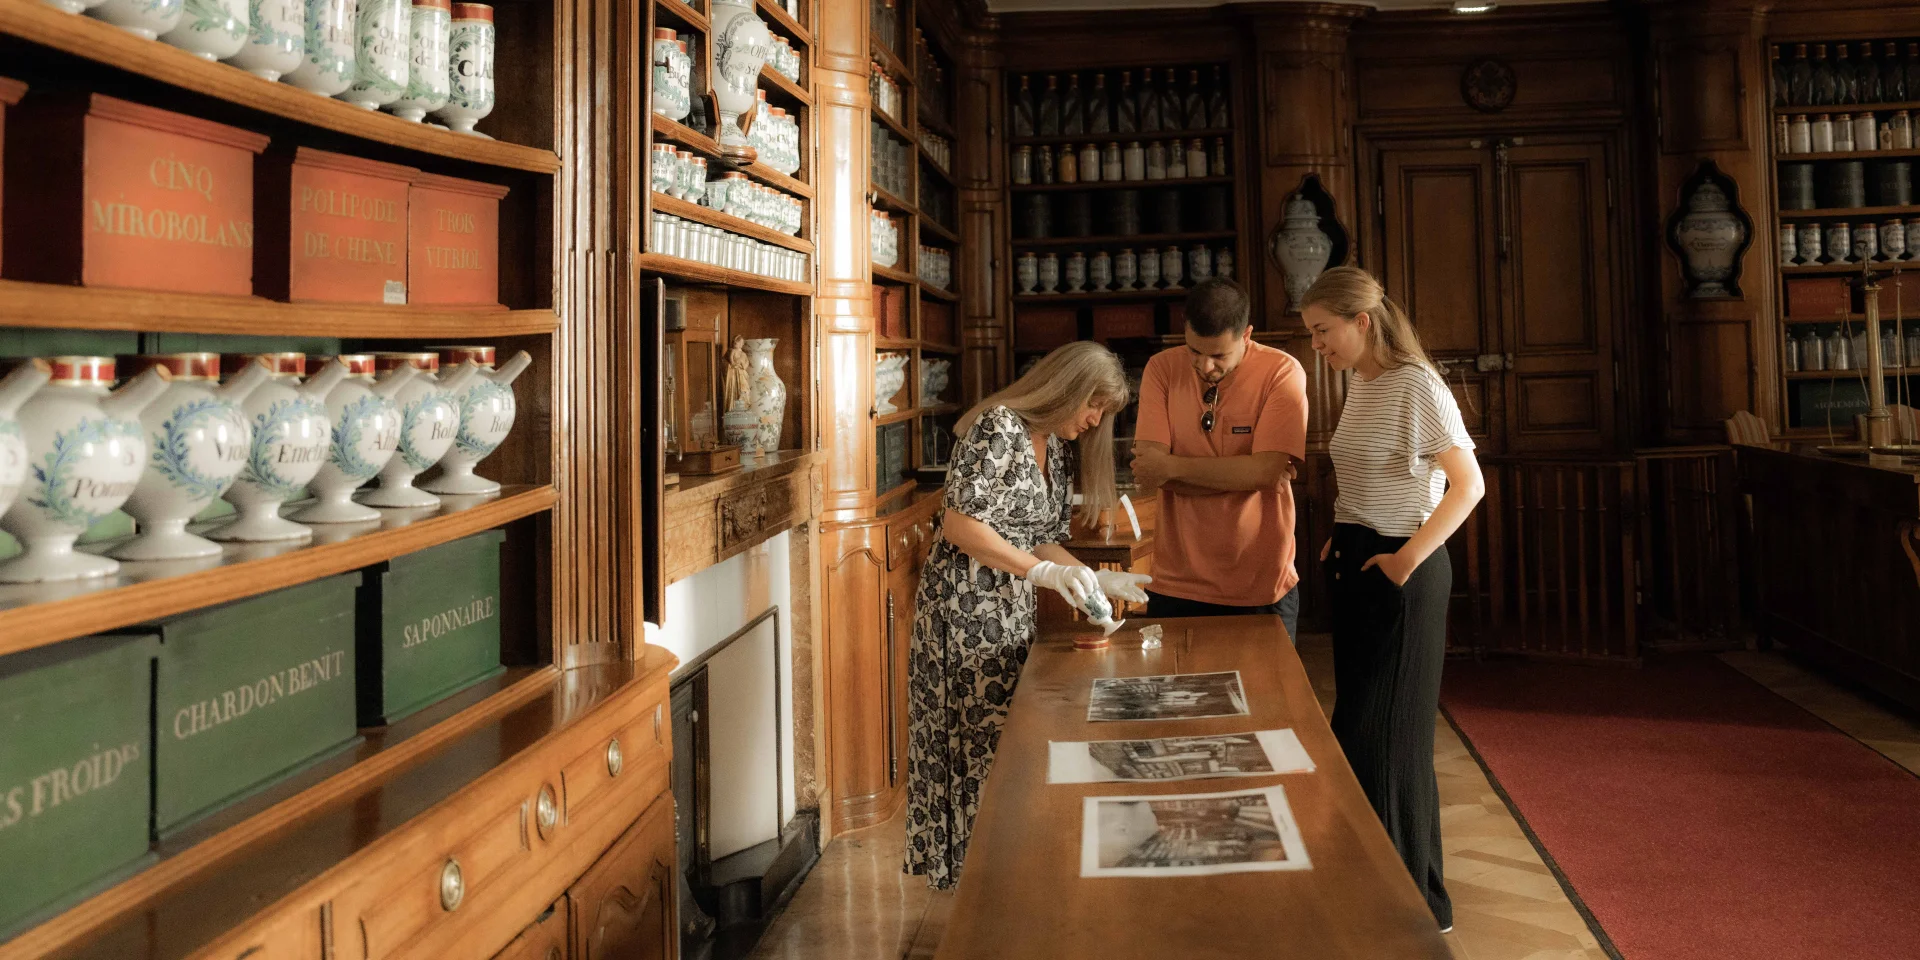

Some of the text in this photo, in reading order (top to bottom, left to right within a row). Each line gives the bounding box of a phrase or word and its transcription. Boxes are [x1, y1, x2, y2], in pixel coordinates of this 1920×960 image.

[150, 152, 214, 202] CINQ
[92, 192, 253, 248] MIROBOLANS
[300, 185, 398, 222] POLIPODE
[436, 208, 475, 234] TROIS
[304, 230, 397, 265] DE CHENE
[426, 246, 482, 270] VITRIOL
[402, 594, 494, 648] SAPONNAIRE
[174, 646, 345, 739] CHARDON BENIT
[29, 742, 140, 817] FROIDES
